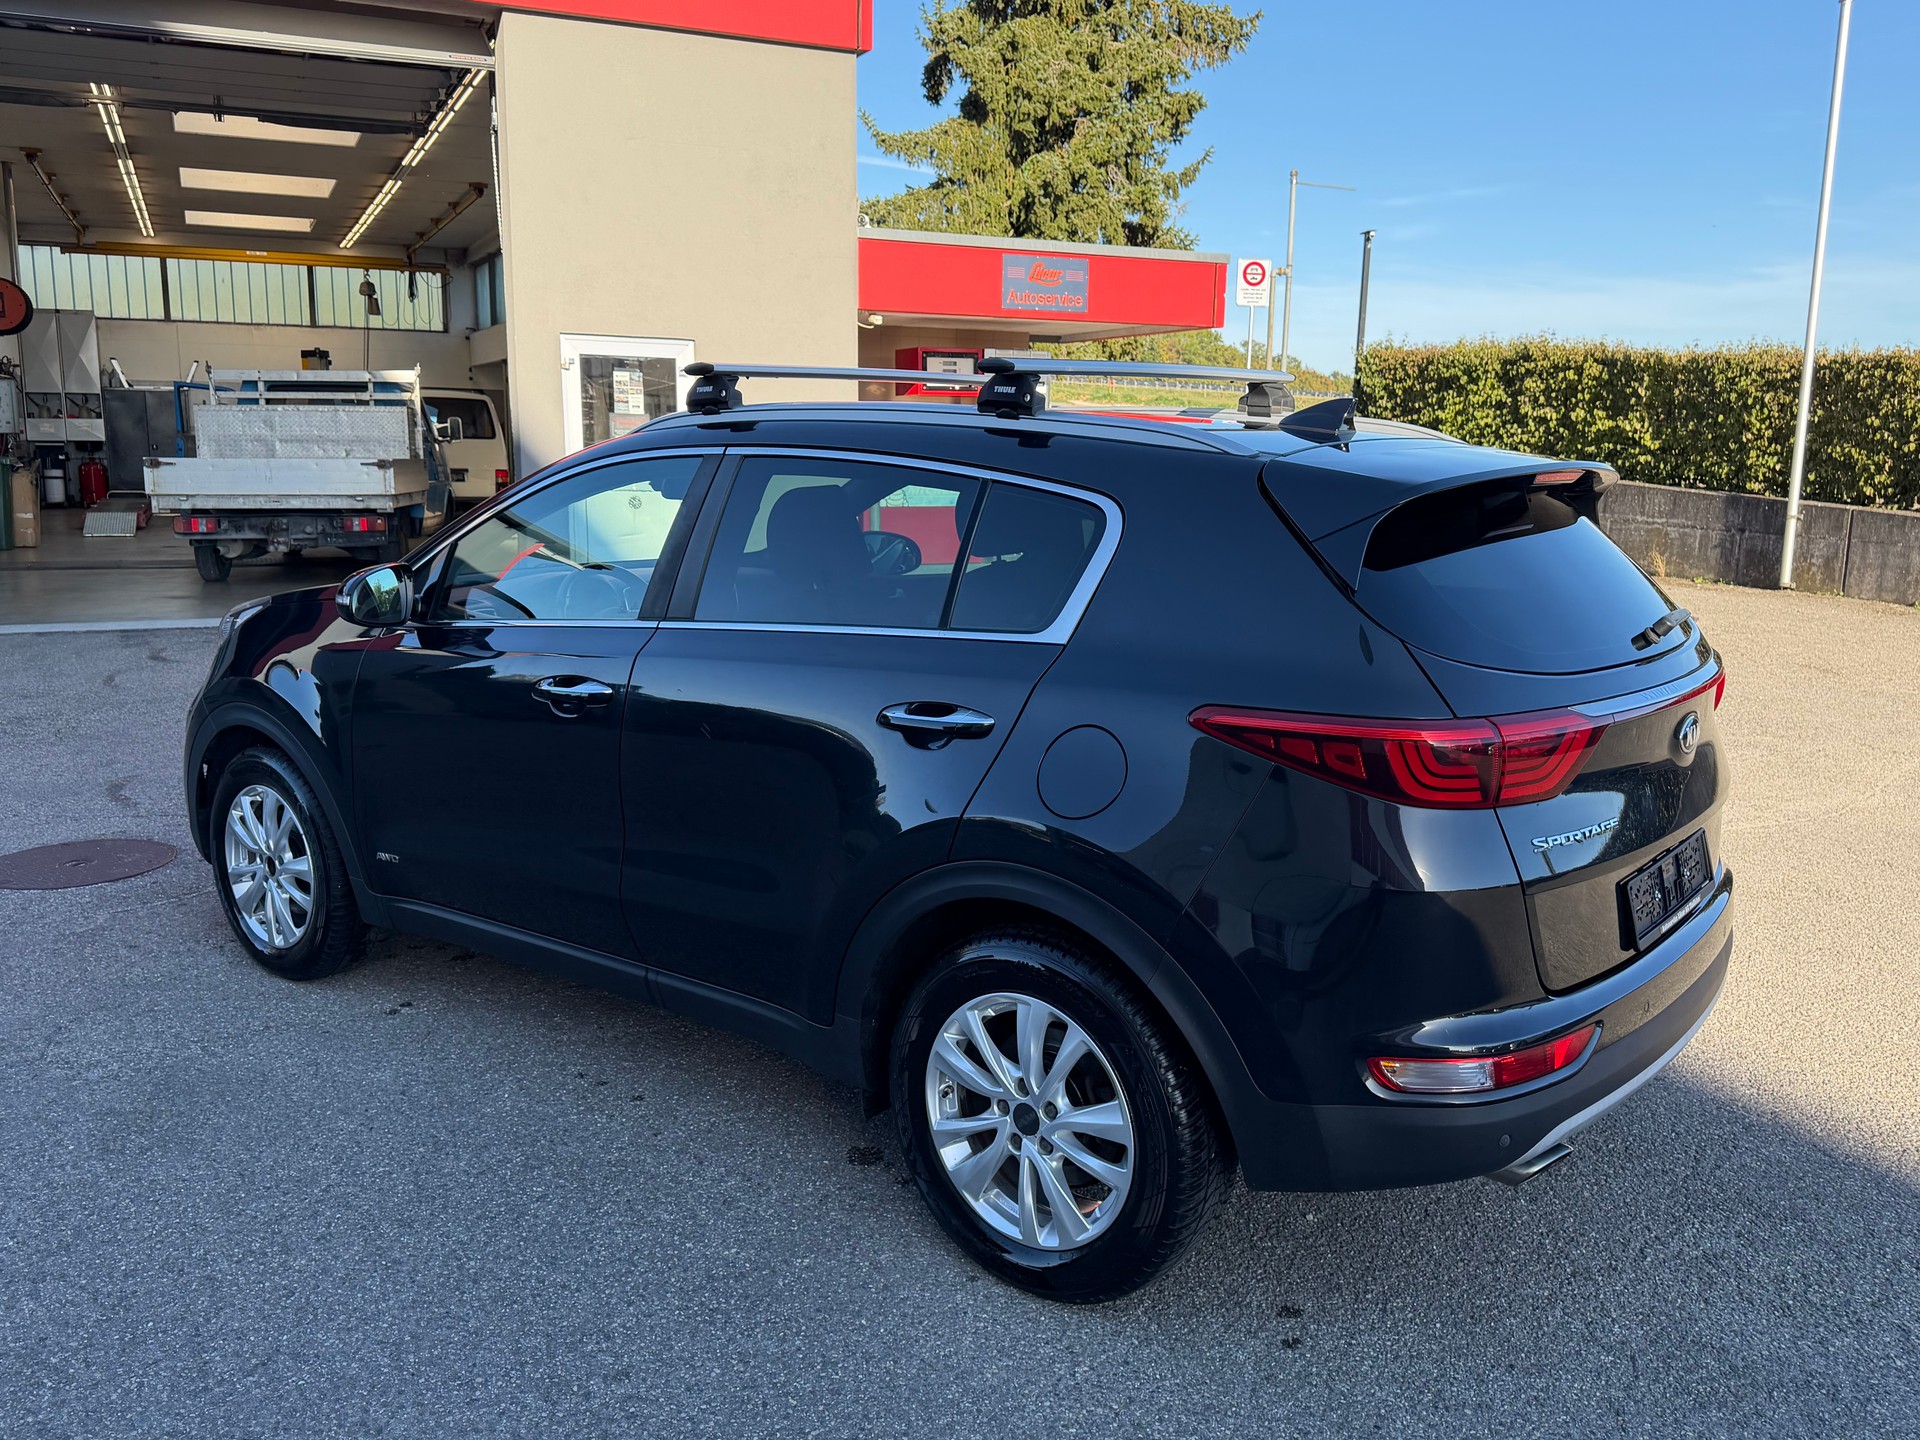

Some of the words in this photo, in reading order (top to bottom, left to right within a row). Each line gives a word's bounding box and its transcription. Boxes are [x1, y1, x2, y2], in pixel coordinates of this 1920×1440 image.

[1006, 288, 1084, 308] Autoservice
[994, 385, 1017, 394] THULE
[1531, 817, 1620, 853] SPORTAGE
